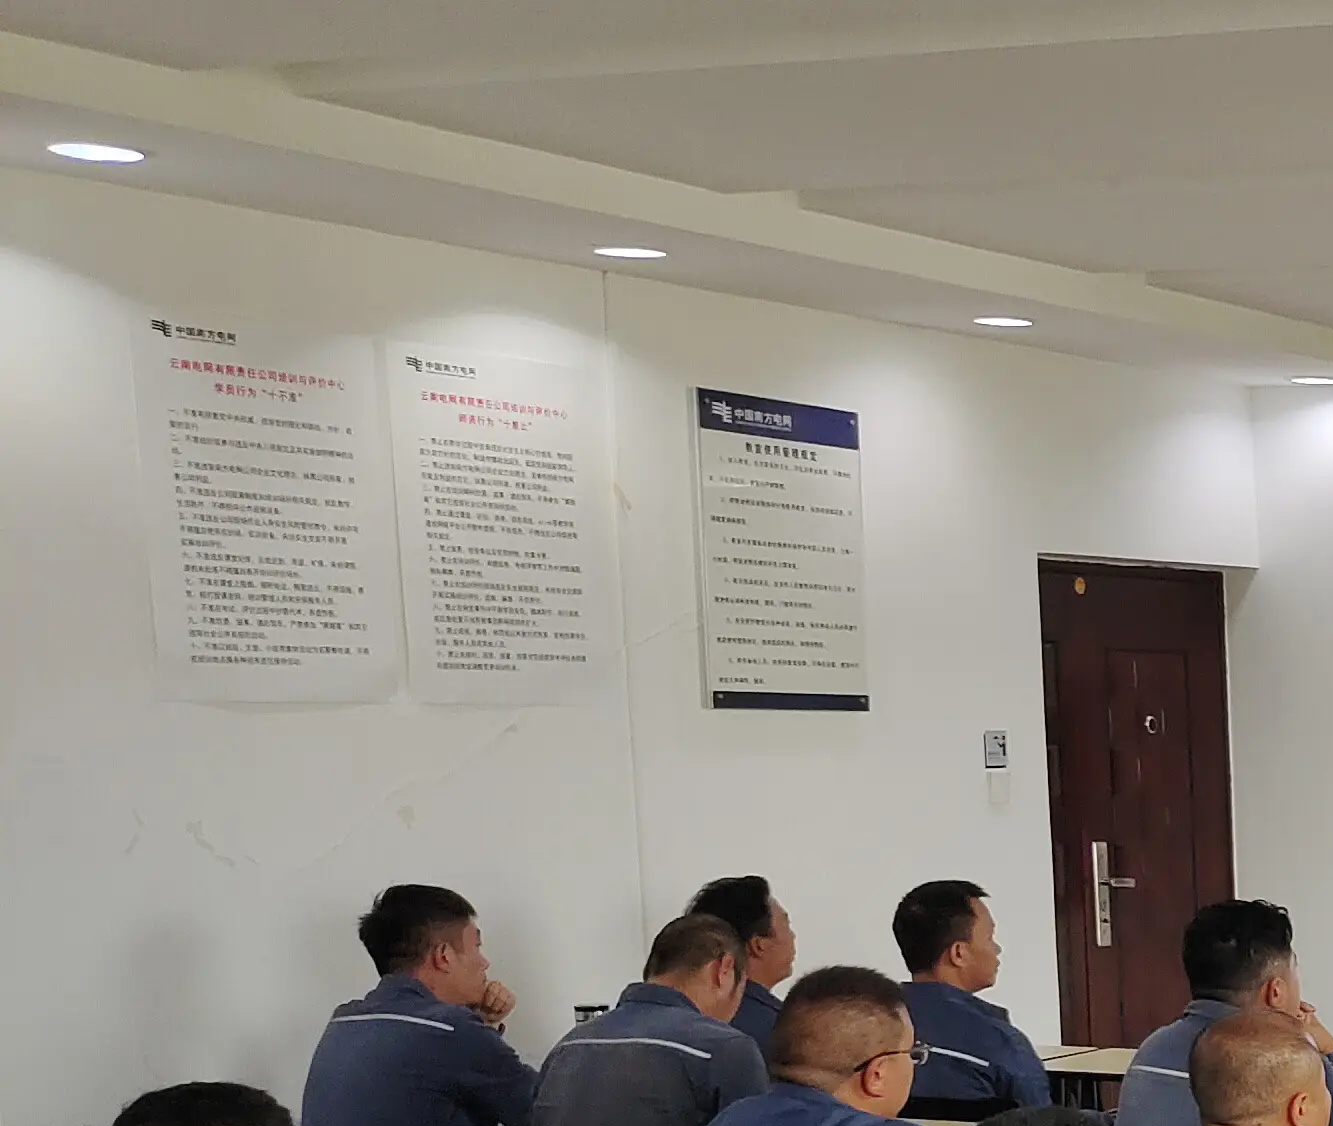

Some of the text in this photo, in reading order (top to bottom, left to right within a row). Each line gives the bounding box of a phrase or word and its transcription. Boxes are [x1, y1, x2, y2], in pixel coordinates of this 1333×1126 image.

[734, 408, 792, 427] 中国南方电网
